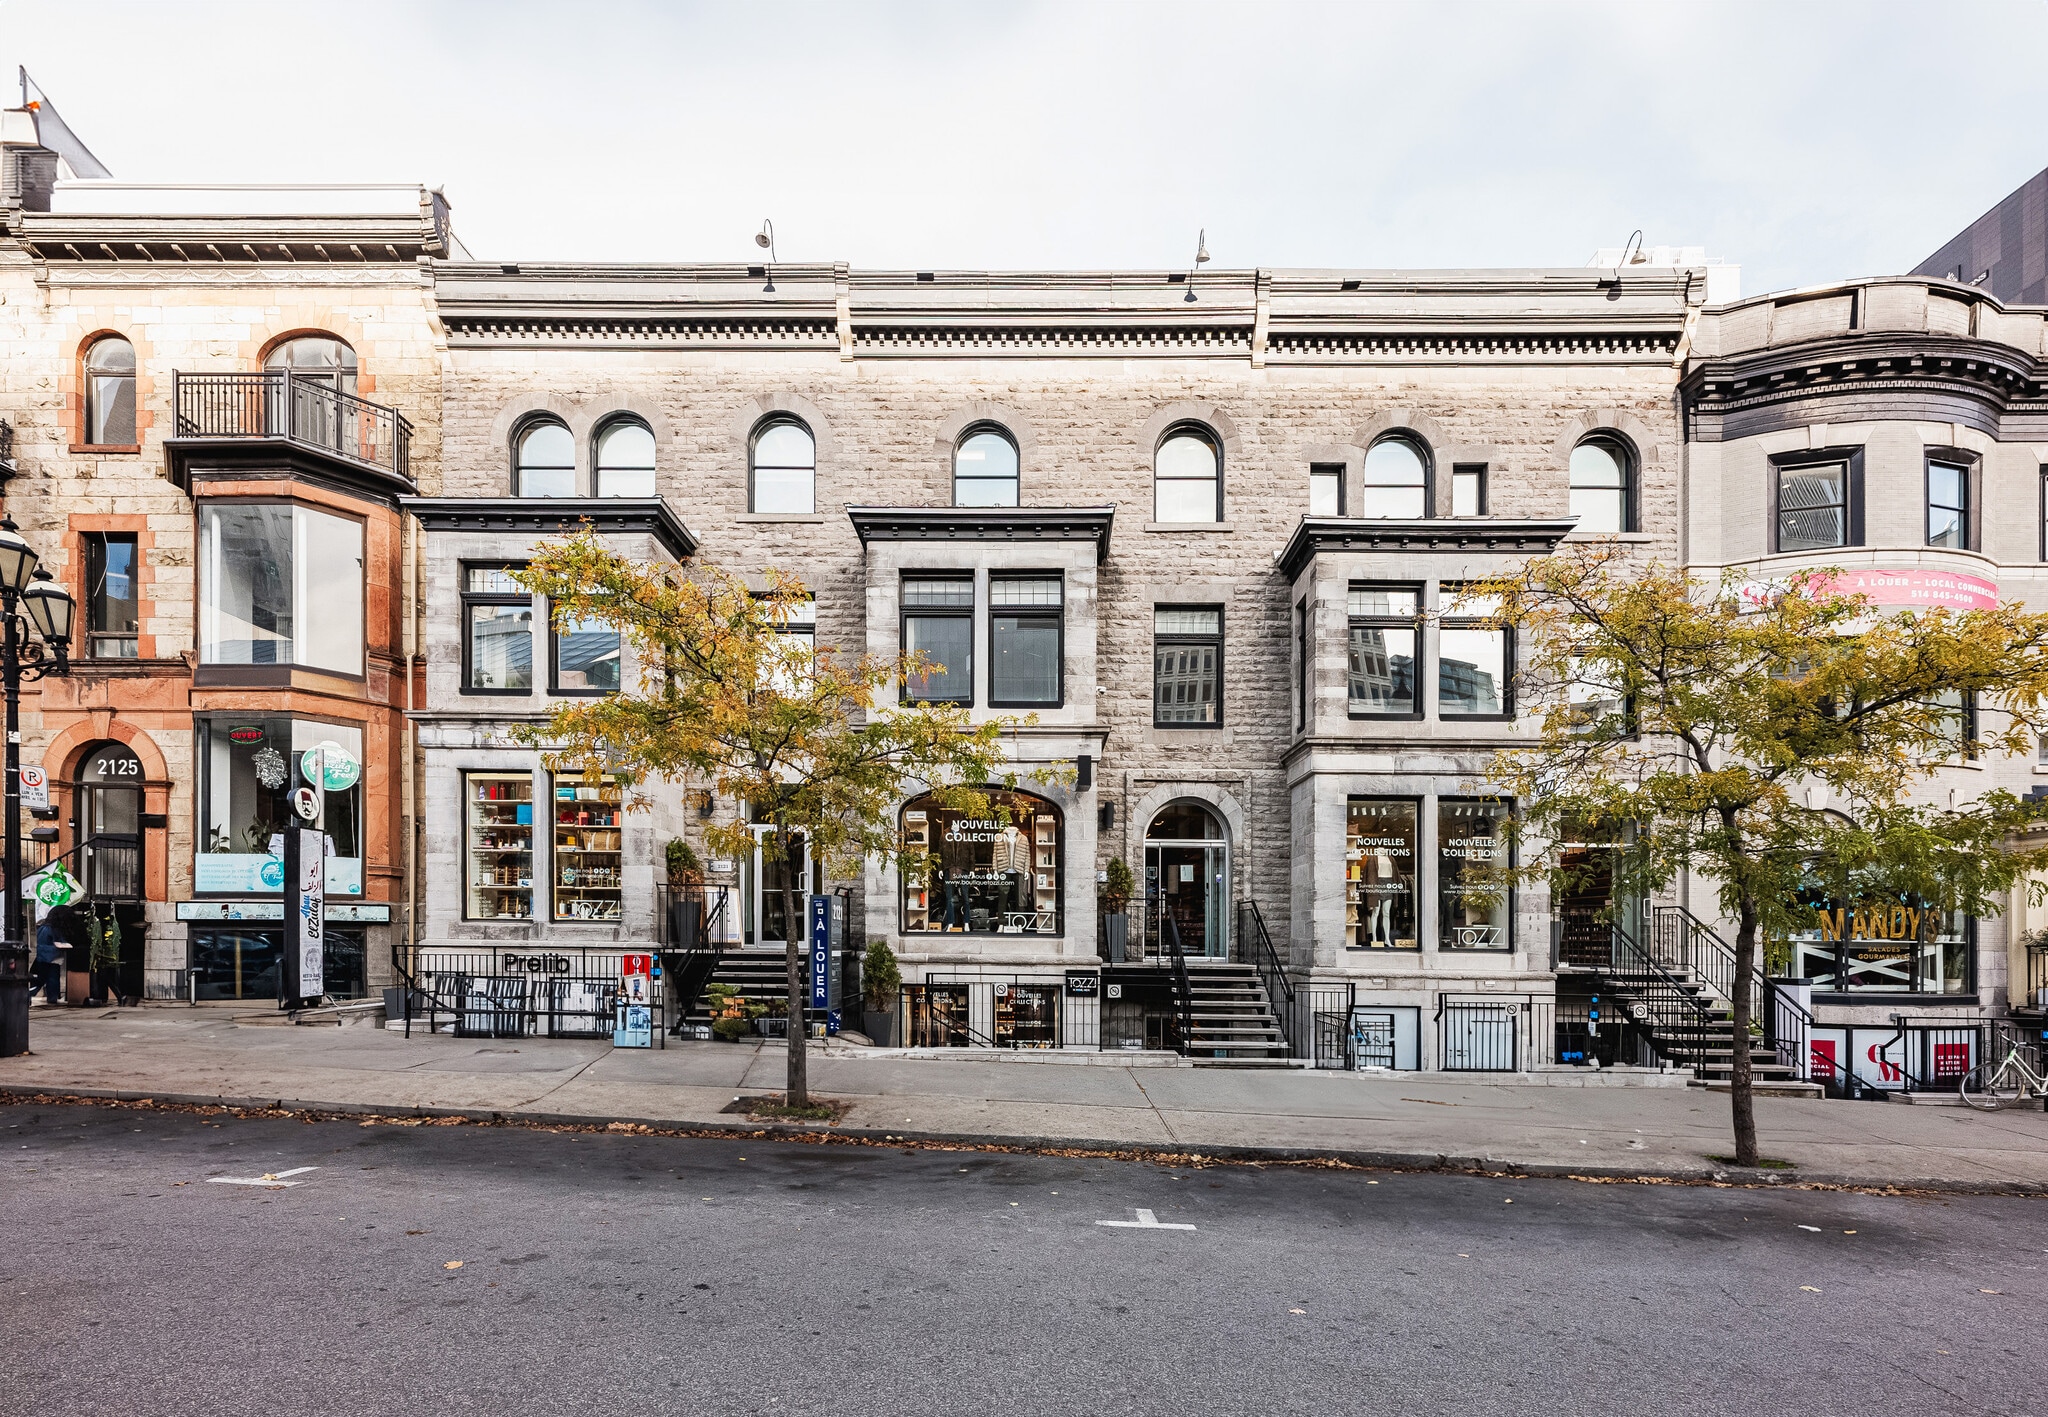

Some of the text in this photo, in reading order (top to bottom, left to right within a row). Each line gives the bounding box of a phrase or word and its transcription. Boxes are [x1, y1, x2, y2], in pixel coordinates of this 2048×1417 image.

[1870, 577, 1909, 587] LOUER
[1925, 578, 1955, 589] LOCAL
[1957, 581, 1997, 600] COMMERCIAL
[1911, 589, 1973, 604] 514 845-4500
[231, 731, 262, 740] OUVERT
[97, 759, 138, 775] 2125
[951, 819, 1009, 830] NOUVELLE
[1357, 837, 1405, 847] NOUVELLES
[1449, 838, 1497, 847] NOUVELLES
[1443, 849, 1502, 858] COLLECTIONS
[569, 899, 620, 918] TOZZI
[1003, 911, 1055, 931] TOZZI
[1818, 906, 1940, 944] MANDY'S
[1452, 927, 1505, 946] TOZZI
[815, 918, 825, 998] À LOUER
[1067, 977, 1097, 988] TOZZI
